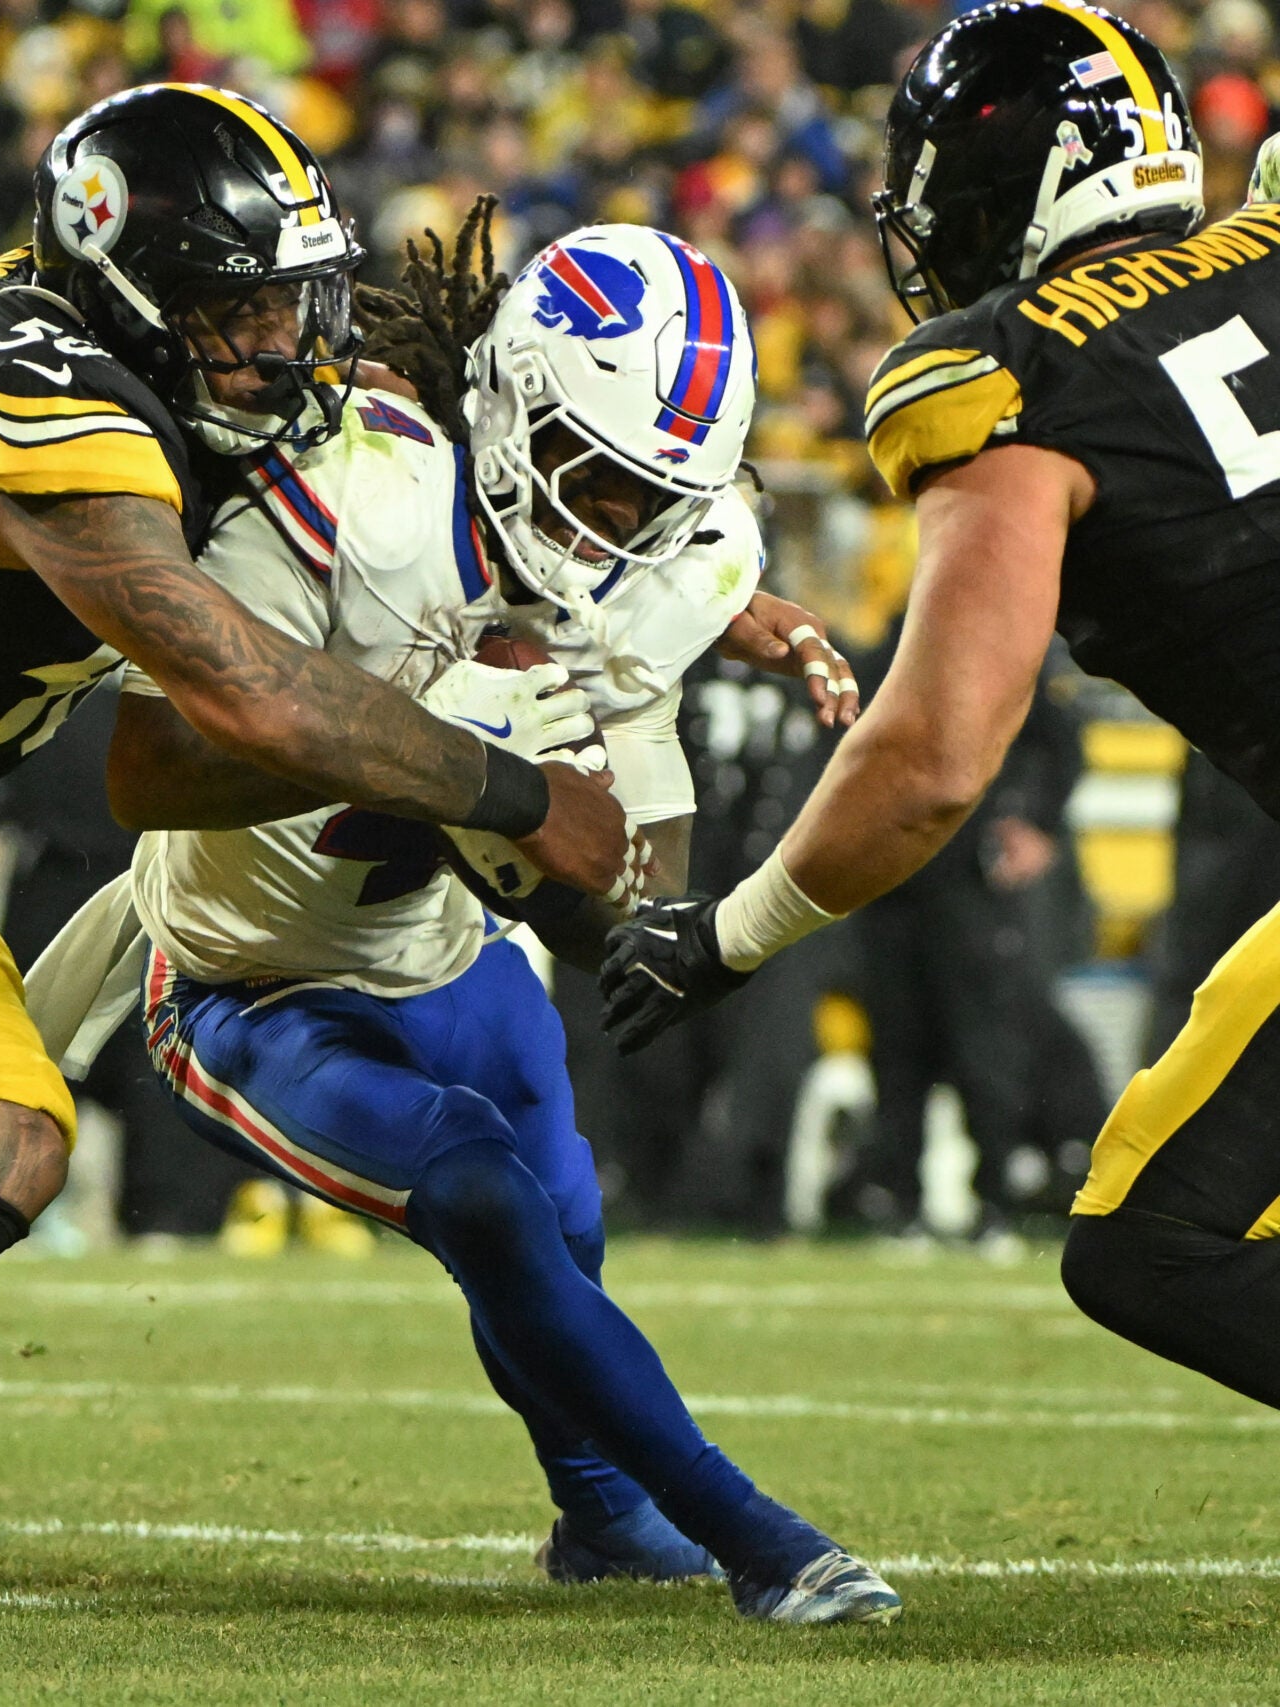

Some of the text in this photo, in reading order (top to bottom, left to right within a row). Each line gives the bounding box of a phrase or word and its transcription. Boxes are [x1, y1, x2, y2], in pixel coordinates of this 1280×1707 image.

[1114, 92, 1183, 158] 56
[1132, 158, 1187, 190] Steelers
[301, 231, 334, 249] Steelers
[217, 265, 264, 274] OAKLEY
